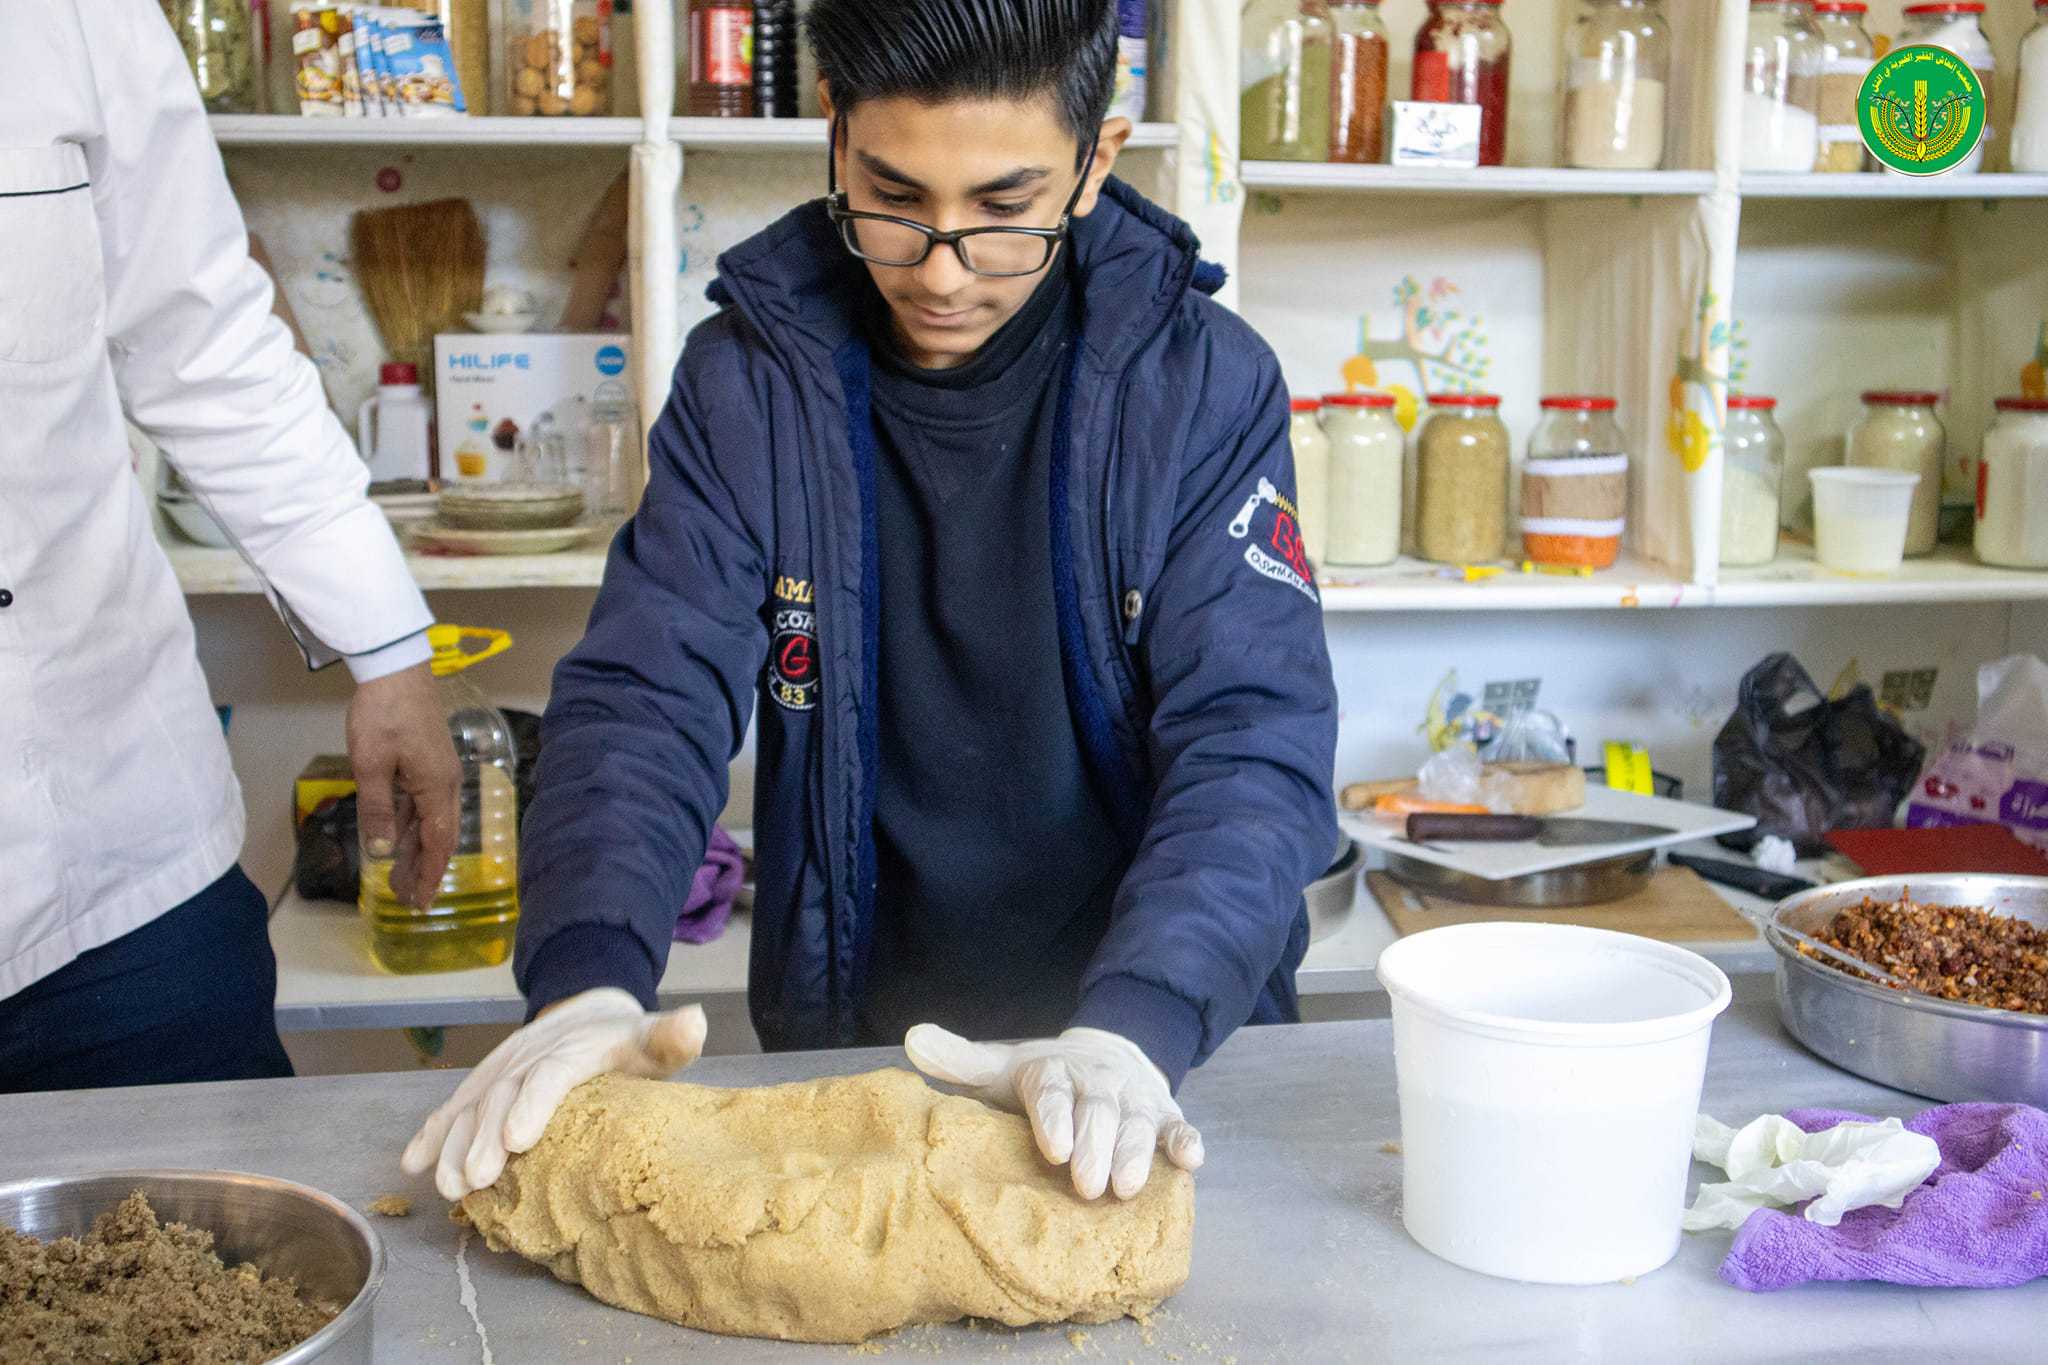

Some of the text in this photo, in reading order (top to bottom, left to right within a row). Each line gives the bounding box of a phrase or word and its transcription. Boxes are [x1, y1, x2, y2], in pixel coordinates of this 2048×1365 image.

[450, 353, 529, 370] HILIFE
[781, 636, 812, 677] G
[781, 685, 806, 705] 83
